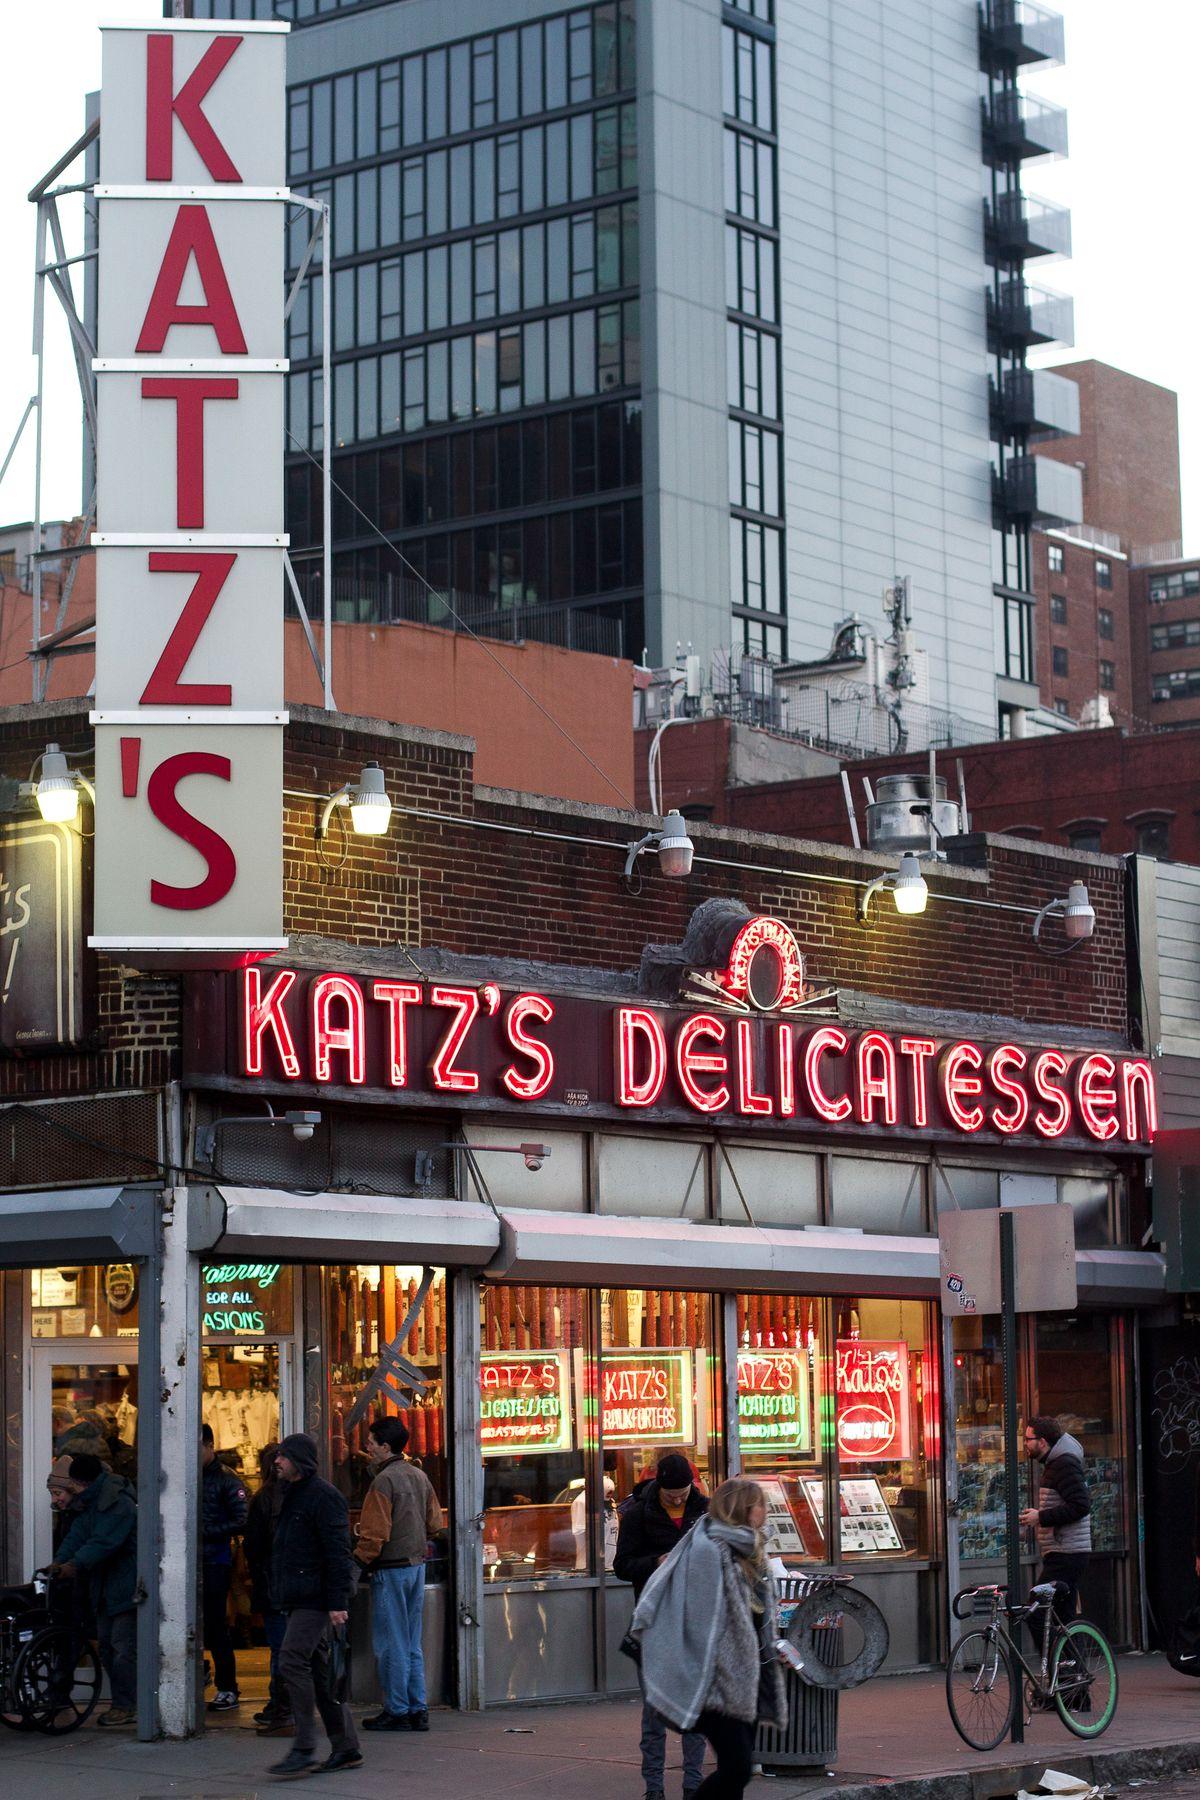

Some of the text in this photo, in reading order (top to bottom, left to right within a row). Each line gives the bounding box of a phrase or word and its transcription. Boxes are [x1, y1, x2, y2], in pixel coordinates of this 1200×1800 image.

[120, 34, 248, 910] KATZ'S
[244, 967, 1159, 1144] KATZ'S DELICATESSEN
[202, 1263, 280, 1288] atering
[232, 1291, 254, 1304] ALL
[203, 1311, 265, 1331] ASIONS
[604, 1367, 667, 1402] KATZ'S
[738, 1356, 792, 1390] ATZ'S
[480, 1396, 559, 1418] LICATESSEN
[738, 1394, 796, 1416] ICATESSEN
[603, 1407, 676, 1431] RANKFURTERS
